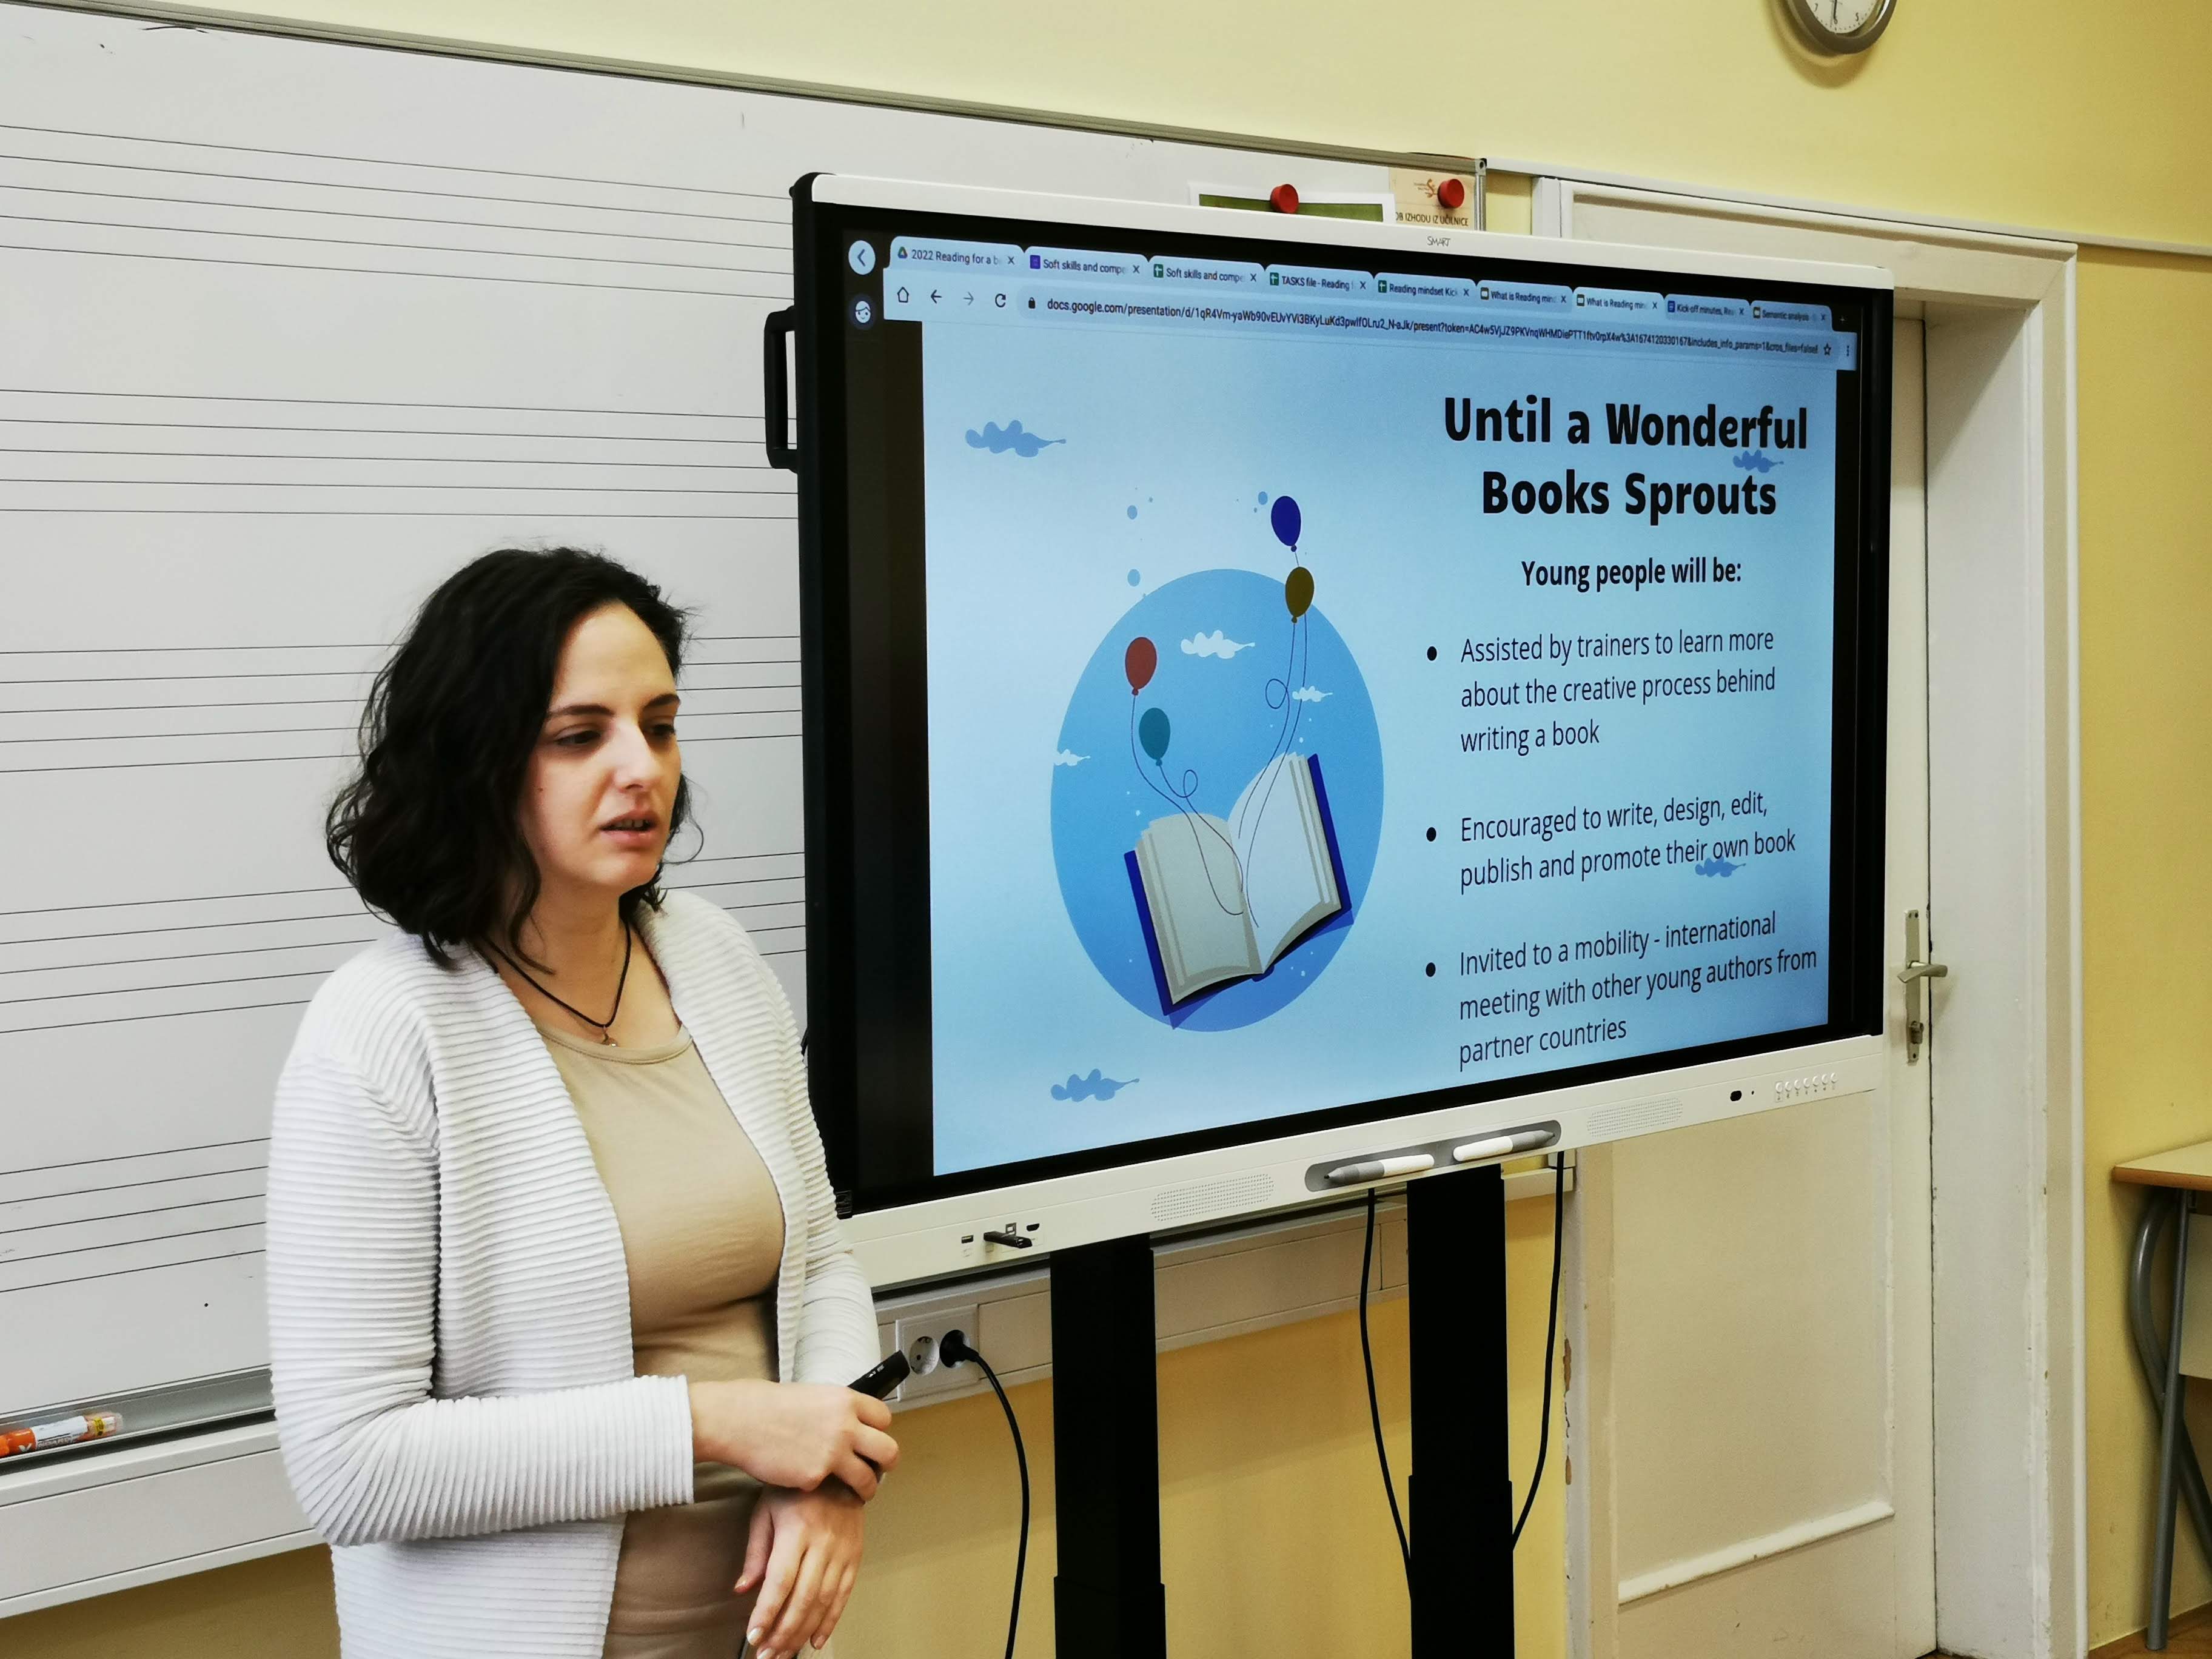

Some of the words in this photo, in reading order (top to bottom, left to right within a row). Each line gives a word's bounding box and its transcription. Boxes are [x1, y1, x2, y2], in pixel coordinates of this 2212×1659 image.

[1405, 212, 1431, 224] IZHODU
[1432, 215, 1439, 224] IZ
[1439, 213, 1469, 227] UČILNICE
[911, 249, 934, 261] 2022
[936, 250, 970, 266] Reading
[972, 253, 984, 264] for
[986, 256, 991, 265] a
[1426, 235, 1451, 247] SMART
[1043, 258, 1060, 270] Soft
[1062, 260, 1081, 271] skills
[1082, 262, 1098, 272] and
[1166, 267, 1182, 278] Soft
[1184, 269, 1202, 280] skills
[1203, 270, 1218, 281] and
[1282, 275, 1305, 287] TASKS
[1306, 277, 1317, 287] file
[1321, 279, 1350, 292] Reading
[1389, 283, 1416, 296] Reading
[1418, 286, 1444, 297] mindset
[1491, 290, 1508, 300] What
[1509, 292, 1515, 301] is
[1515, 292, 1541, 304] Reading
[1586, 297, 1603, 307] What
[1609, 299, 1634, 310] Reading
[1445, 394, 1550, 443] Until
[1567, 411, 1590, 444] a
[1605, 403, 1807, 449] Wonderful
[1483, 469, 1609, 515] Books
[1625, 471, 1777, 526] Sprouts
[1521, 560, 1590, 593] Young
[1597, 557, 1666, 593] people
[1671, 556, 1706, 583] will
[1713, 556, 1741, 583] be:
[1461, 634, 1543, 663] Assisted
[1550, 633, 1572, 666] by
[1577, 633, 1650, 658] trainers
[1655, 632, 1673, 654] to
[1679, 629, 1723, 654] learn
[1729, 632, 1774, 651] more
[1461, 680, 1520, 708] about
[1525, 678, 1557, 704] the
[1563, 675, 1637, 702] creative
[1643, 676, 1711, 705] process
[1717, 666, 1775, 693] behind
[1460, 725, 1530, 757] writing
[1535, 728, 1545, 747] a
[1553, 718, 1600, 746] book
[1461, 807, 1576, 842] Encouraged
[1583, 808, 1601, 830] to
[1607, 802, 1657, 828] write,
[1664, 796, 1725, 826] design,
[1731, 790, 1767, 817] edit,
[1461, 855, 1532, 896] publish
[1539, 850, 1575, 878] and
[1581, 845, 1661, 882] promote
[1666, 839, 1708, 864] their
[1713, 838, 1749, 859] own
[1754, 828, 1796, 855] book
[1461, 942, 1526, 976] Invited
[1532, 943, 1552, 966] to
[1558, 943, 1568, 962] a
[1575, 929, 1650, 960] mobility
[1666, 910, 1775, 948] international
[1460, 988, 1541, 1021] meeting
[1545, 978, 1586, 1007] with
[1592, 973, 1642, 1000] other
[1646, 967, 1702, 1000] young
[1706, 955, 1772, 984] authors
[1777, 948, 1817, 973] from
[1460, 1034, 1534, 1073] partner
[1540, 1018, 1627, 1051] countries
